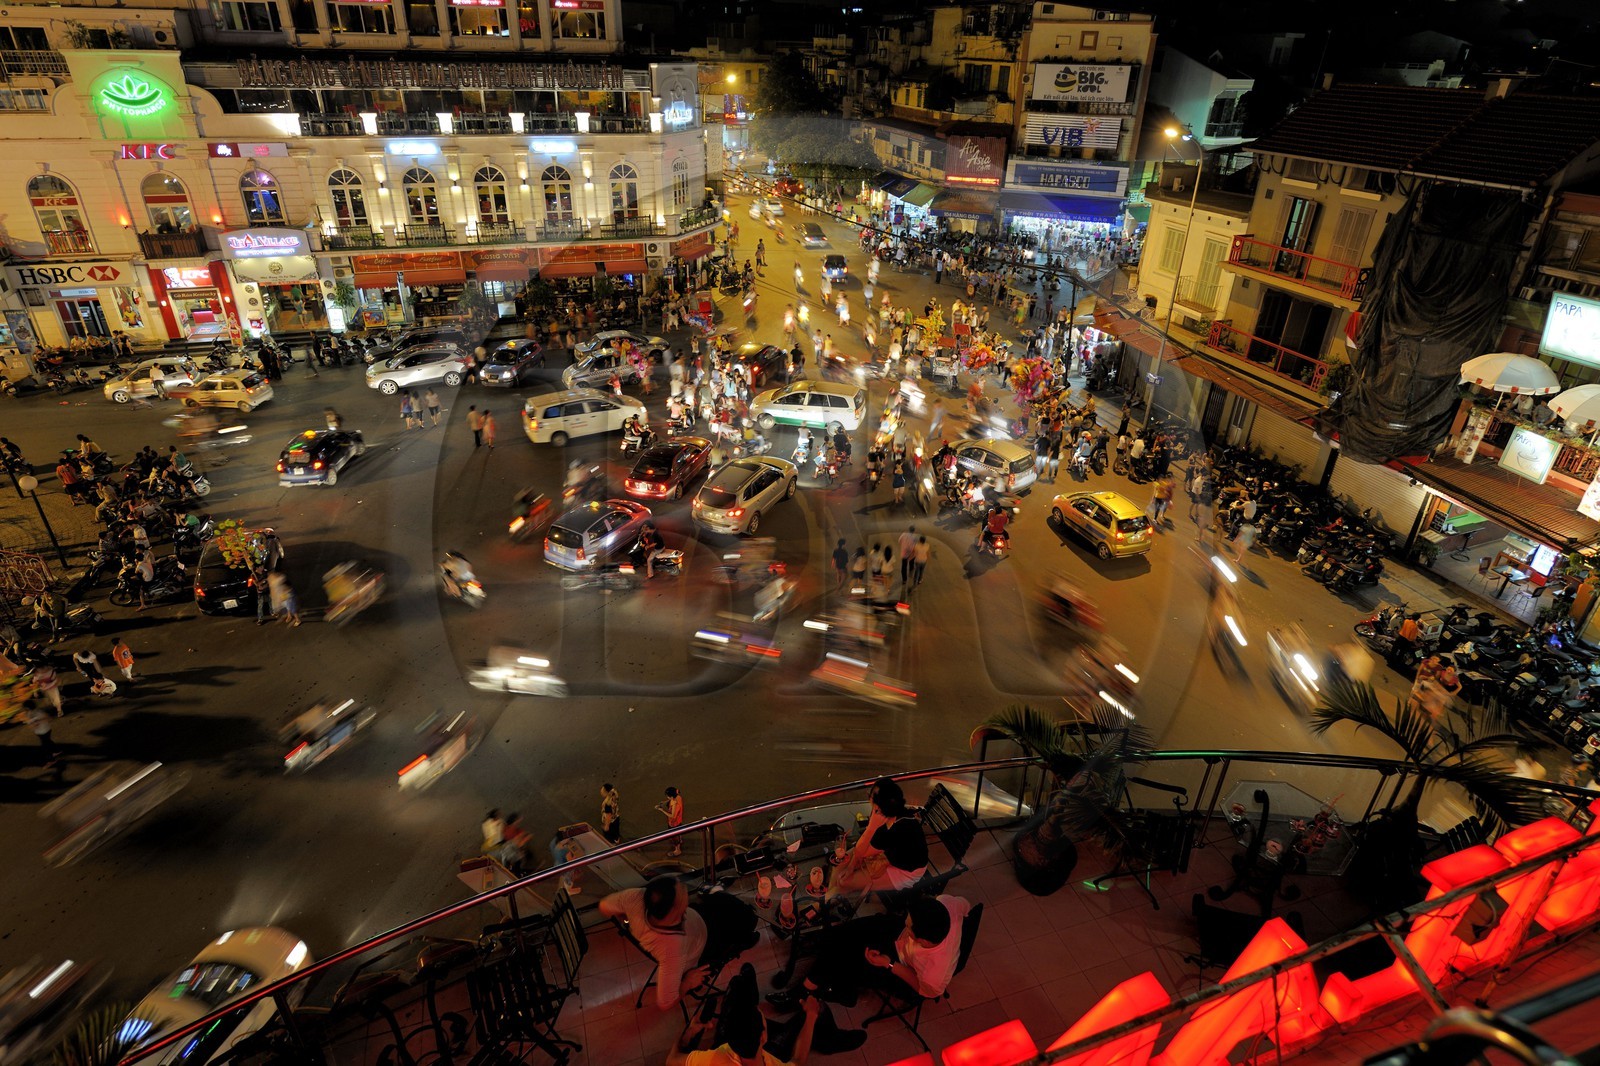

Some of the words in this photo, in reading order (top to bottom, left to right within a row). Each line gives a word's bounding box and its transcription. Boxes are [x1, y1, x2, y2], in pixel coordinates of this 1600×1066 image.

[1078, 71, 1105, 84] BIG
[1077, 85, 1101, 93] KOOL
[1043, 127, 1083, 146] VIB
[122, 143, 175, 159] KFC
[959, 139, 979, 159] Air
[967, 150, 991, 169] Asia
[44, 197, 68, 206] KFC
[16, 266, 86, 286] HSBC
[1555, 301, 1582, 318] PAPA
